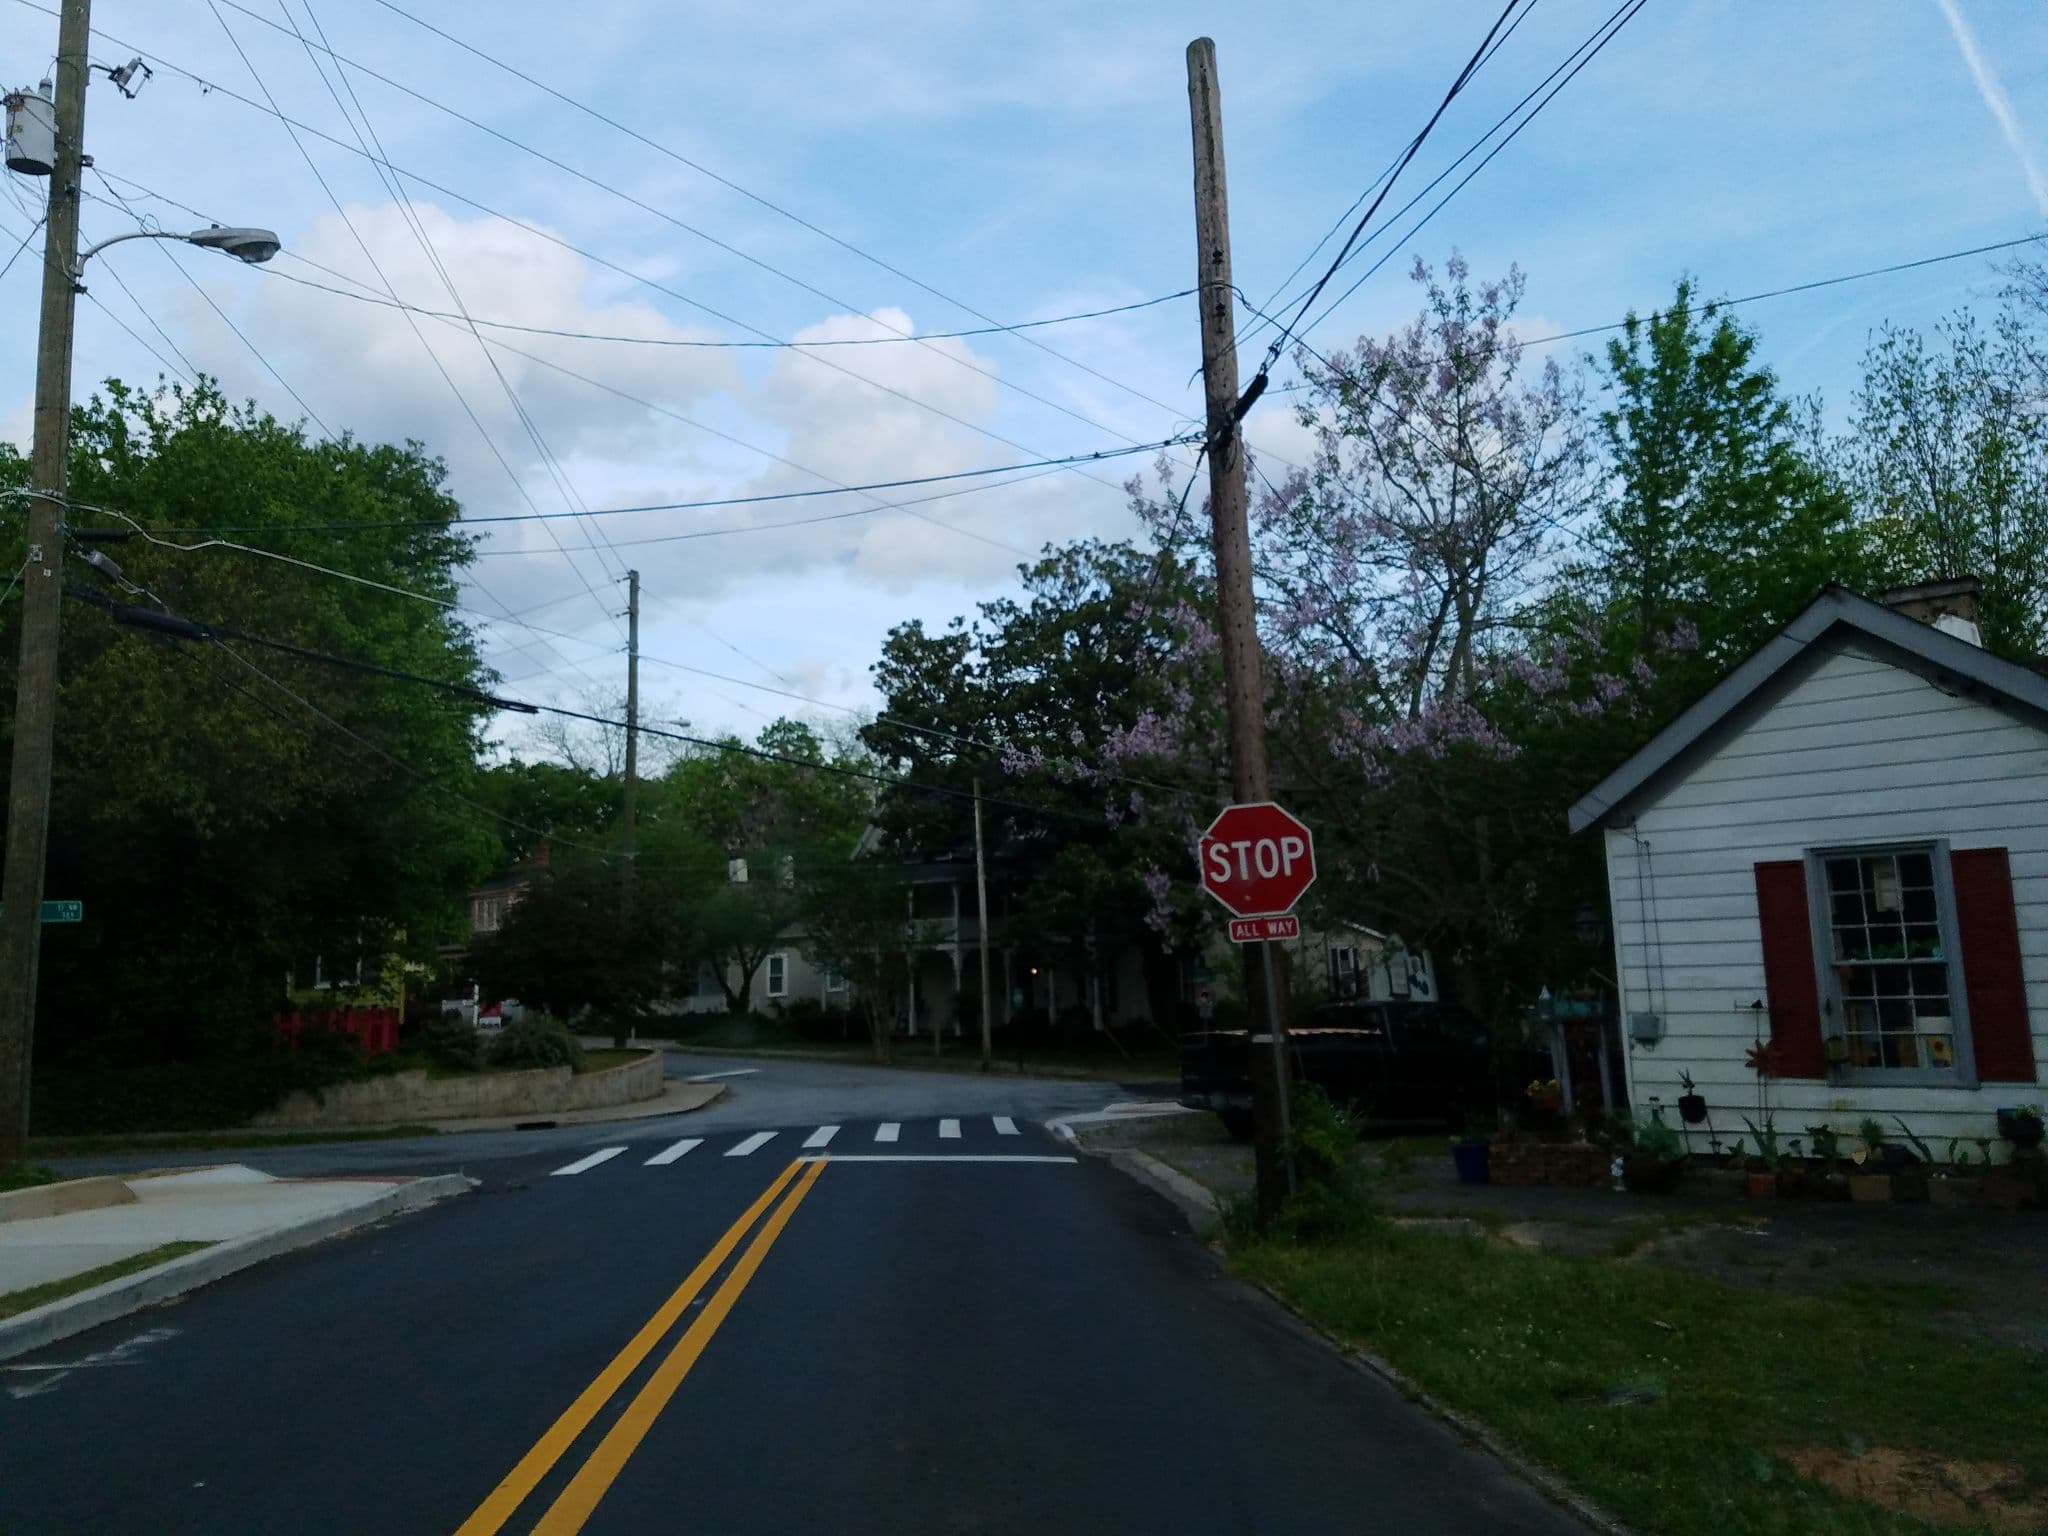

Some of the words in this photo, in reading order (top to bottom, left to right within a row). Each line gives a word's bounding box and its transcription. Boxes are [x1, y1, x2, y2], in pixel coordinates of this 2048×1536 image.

[1209, 836, 1304, 883] STOP
[1236, 924, 1260, 937] ALL
[1267, 921, 1293, 935] WAY
